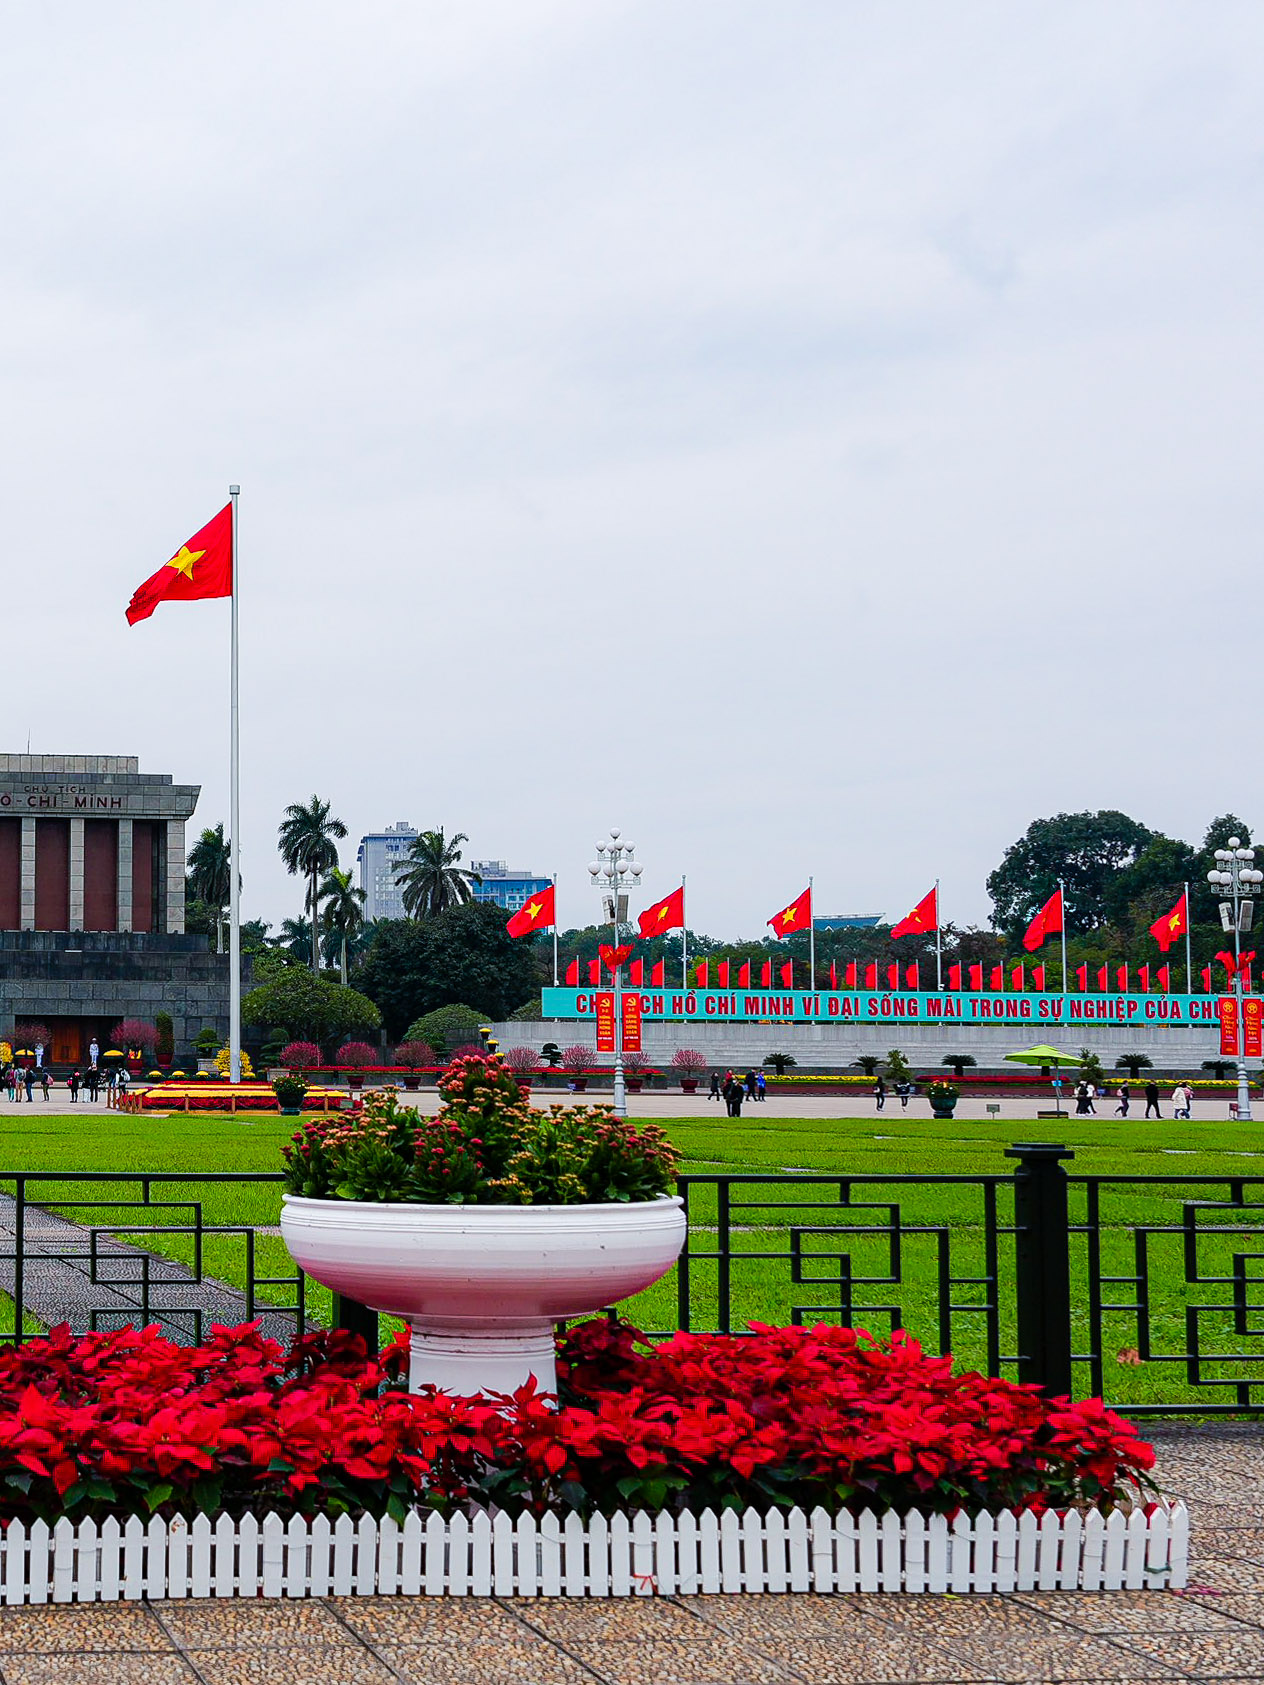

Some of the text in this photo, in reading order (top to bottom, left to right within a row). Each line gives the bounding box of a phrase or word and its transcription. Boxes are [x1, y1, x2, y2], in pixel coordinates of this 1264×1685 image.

[672, 990, 697, 1014] HỒ
[705, 992, 736, 1015] CHÍ
[744, 996, 794, 1016] MINH
[802, 993, 820, 1016] VĨ
[827, 997, 859, 1019] ĐẠI
[868, 993, 918, 1017] SỐNG
[926, 995, 962, 1017] MÃI
[969, 998, 1031, 1018] TRONG
[1039, 997, 1064, 1021] SỰ
[1070, 996, 1138, 1022] NGHIỆP
[1145, 995, 1182, 1019] CỦA
